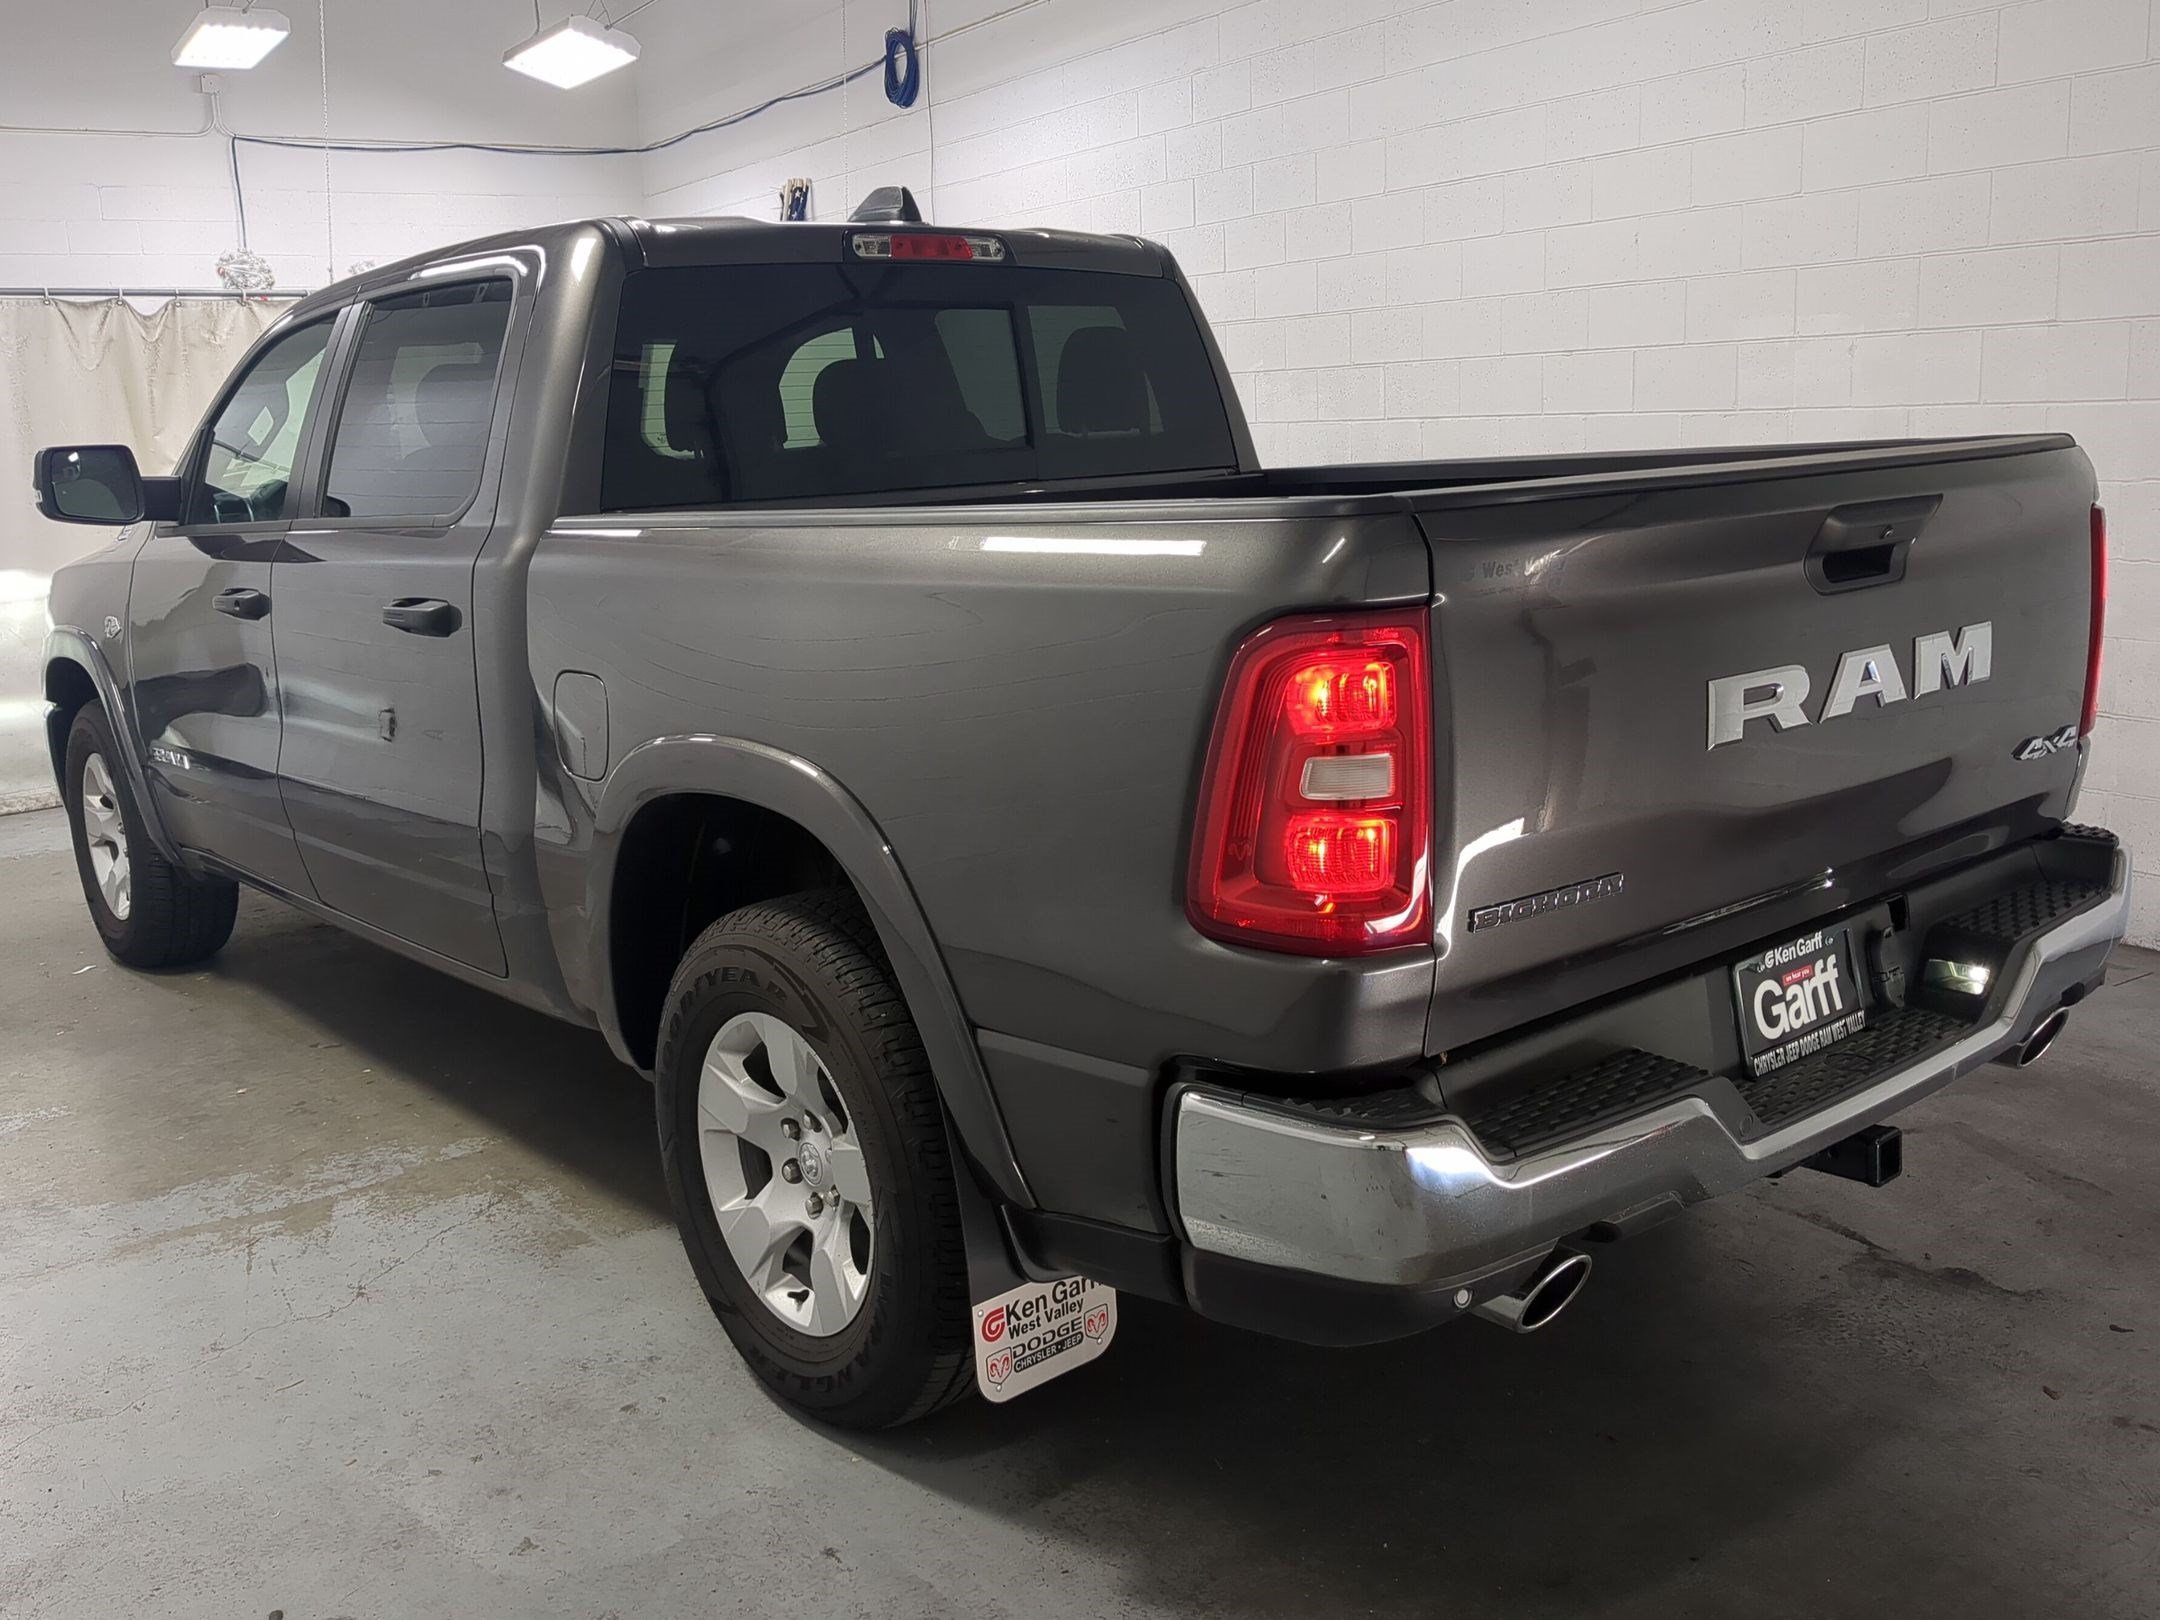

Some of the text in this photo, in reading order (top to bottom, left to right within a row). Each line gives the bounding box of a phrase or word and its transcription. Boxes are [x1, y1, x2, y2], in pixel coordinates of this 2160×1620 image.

[1707, 620, 1992, 751] RAM
[1774, 931, 1823, 966] Ken Garff
[1754, 954, 1843, 1040] Garff
[1785, 1040, 1800, 1064] JEEP
[1799, 1031, 1821, 1057] DODGE
[1819, 1025, 1833, 1048] RAM
[1830, 1018, 1848, 1042] WEST
[1845, 1010, 1866, 1035] VALLEY
[1006, 1277, 1103, 1326] Ken Gar
[1008, 1298, 1084, 1340] West Valley
[1013, 1316, 1083, 1359] DODGE
[1015, 1333, 1082, 1372] CHRYSLER JEEP
